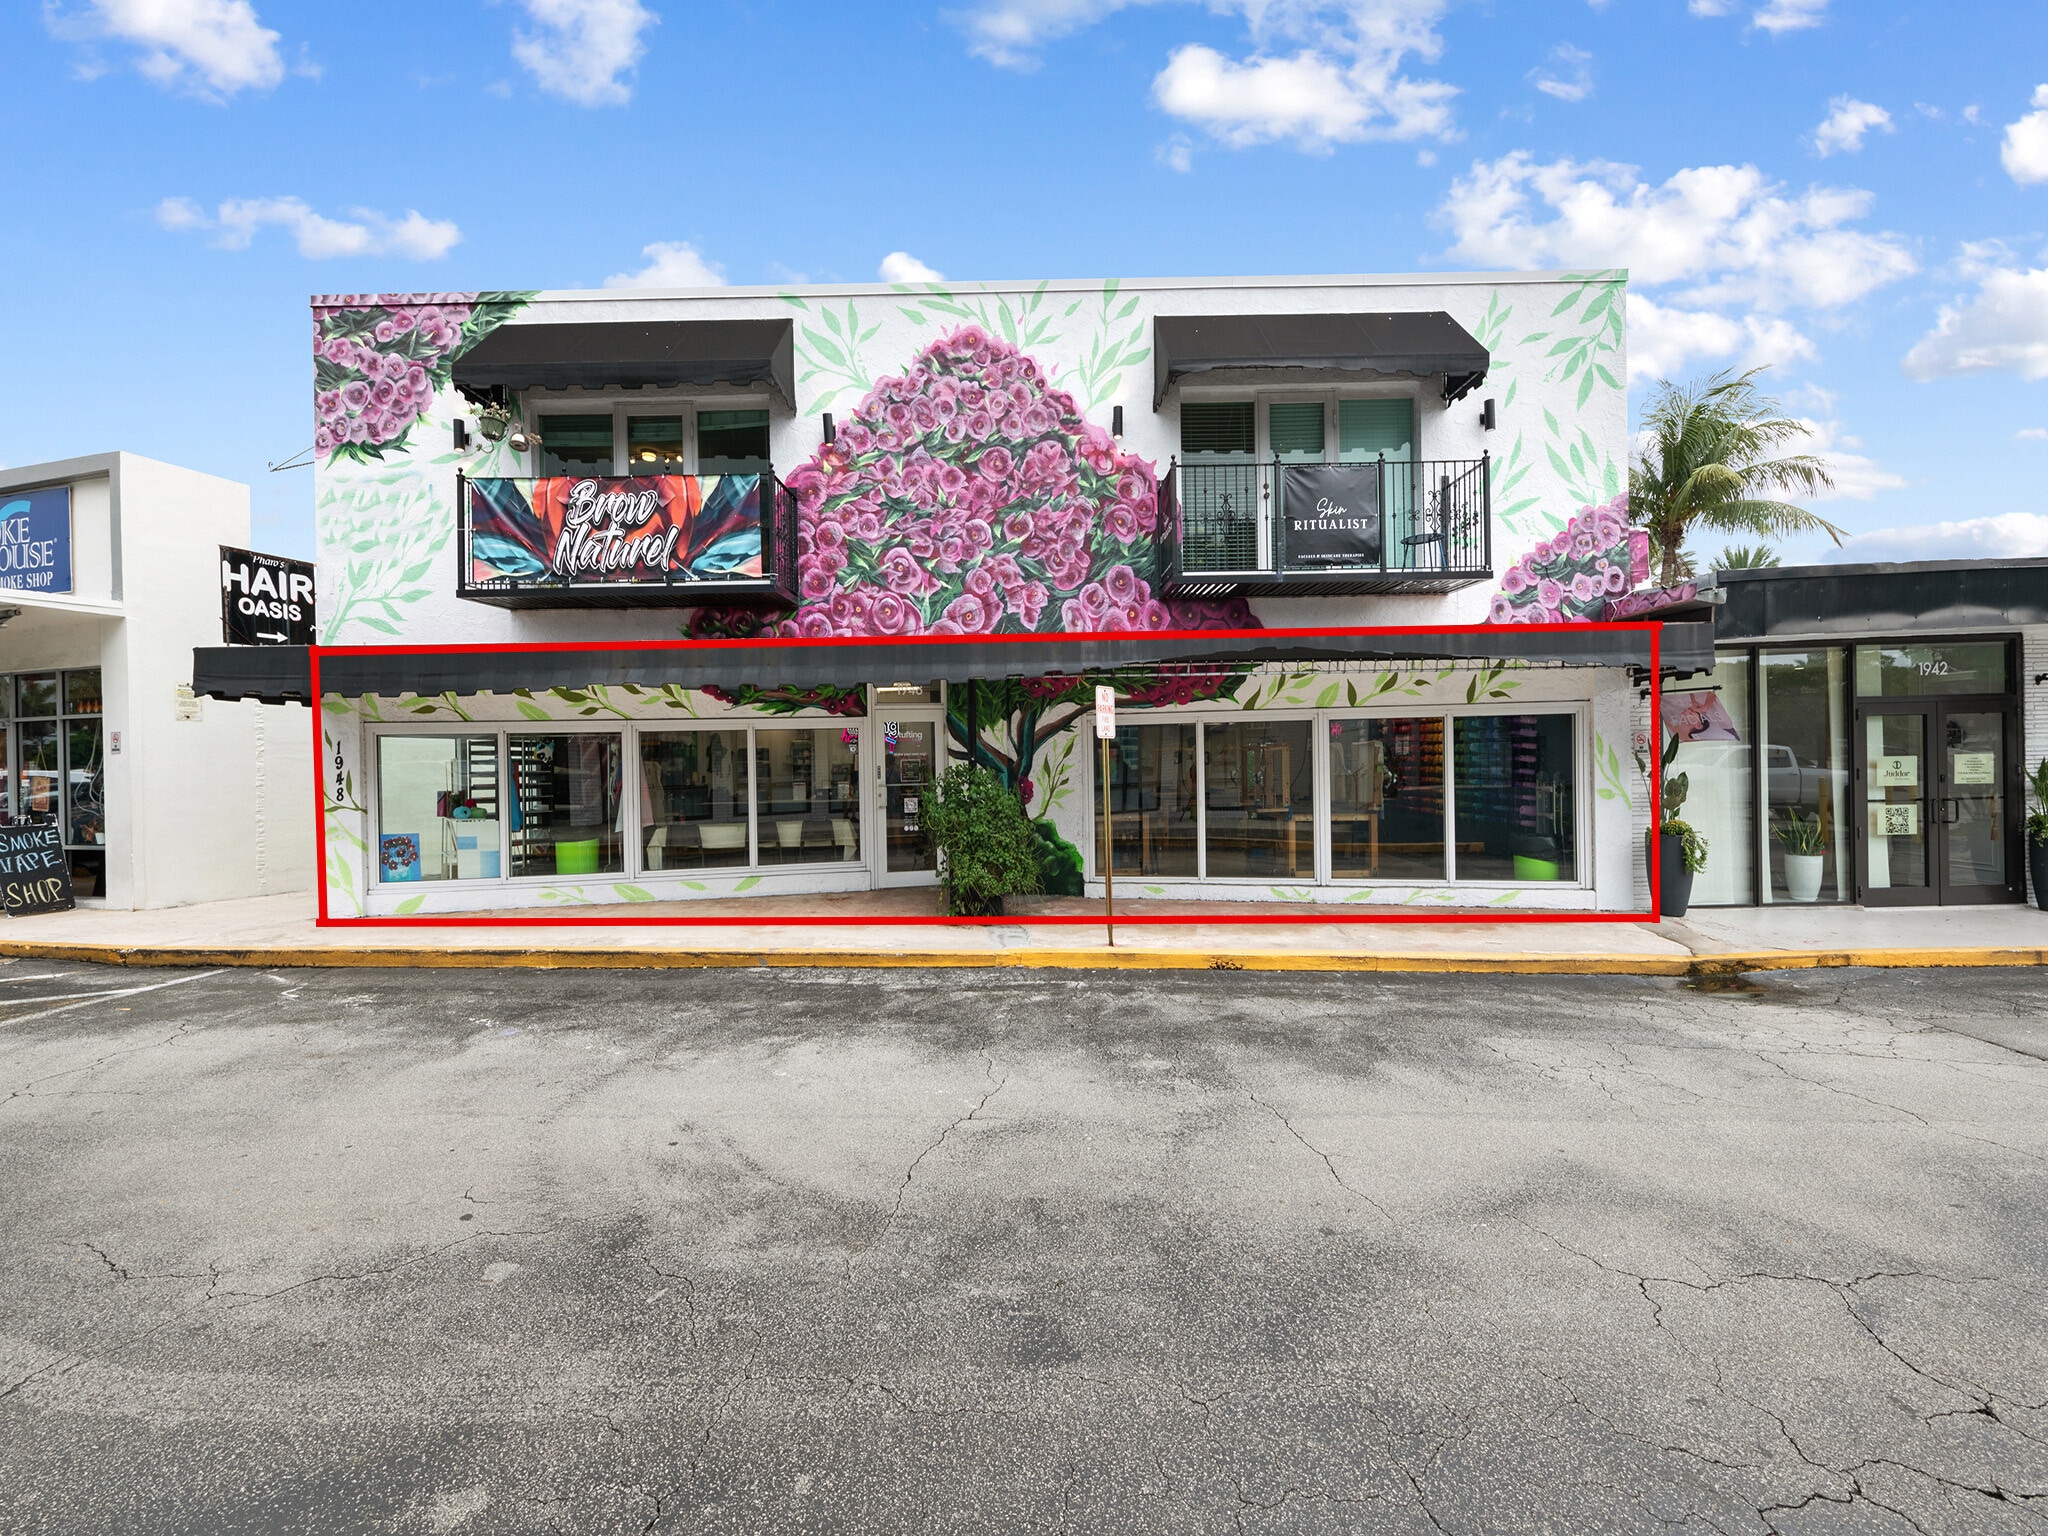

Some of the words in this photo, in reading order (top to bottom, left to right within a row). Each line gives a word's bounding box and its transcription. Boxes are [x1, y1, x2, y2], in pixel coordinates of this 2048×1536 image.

[566, 479, 659, 528] Brow
[1316, 497, 1348, 519] Skin
[0, 517, 31, 546] KE
[1294, 518, 1368, 531] RITUALIST
[553, 521, 680, 576] Naturel
[26, 571, 54, 588] SHOP
[222, 560, 314, 605] HAIR
[238, 597, 302, 622] OASIS
[1918, 661, 1948, 676] 1942
[1097, 704, 1114, 715] PARKING
[1101, 692, 1109, 703] NO
[898, 731, 923, 741] tufting
[334, 740, 344, 802] 1948
[0, 829, 59, 853] SMOKE
[0, 850, 61, 874] VAPE
[5, 877, 66, 908] SHOP
